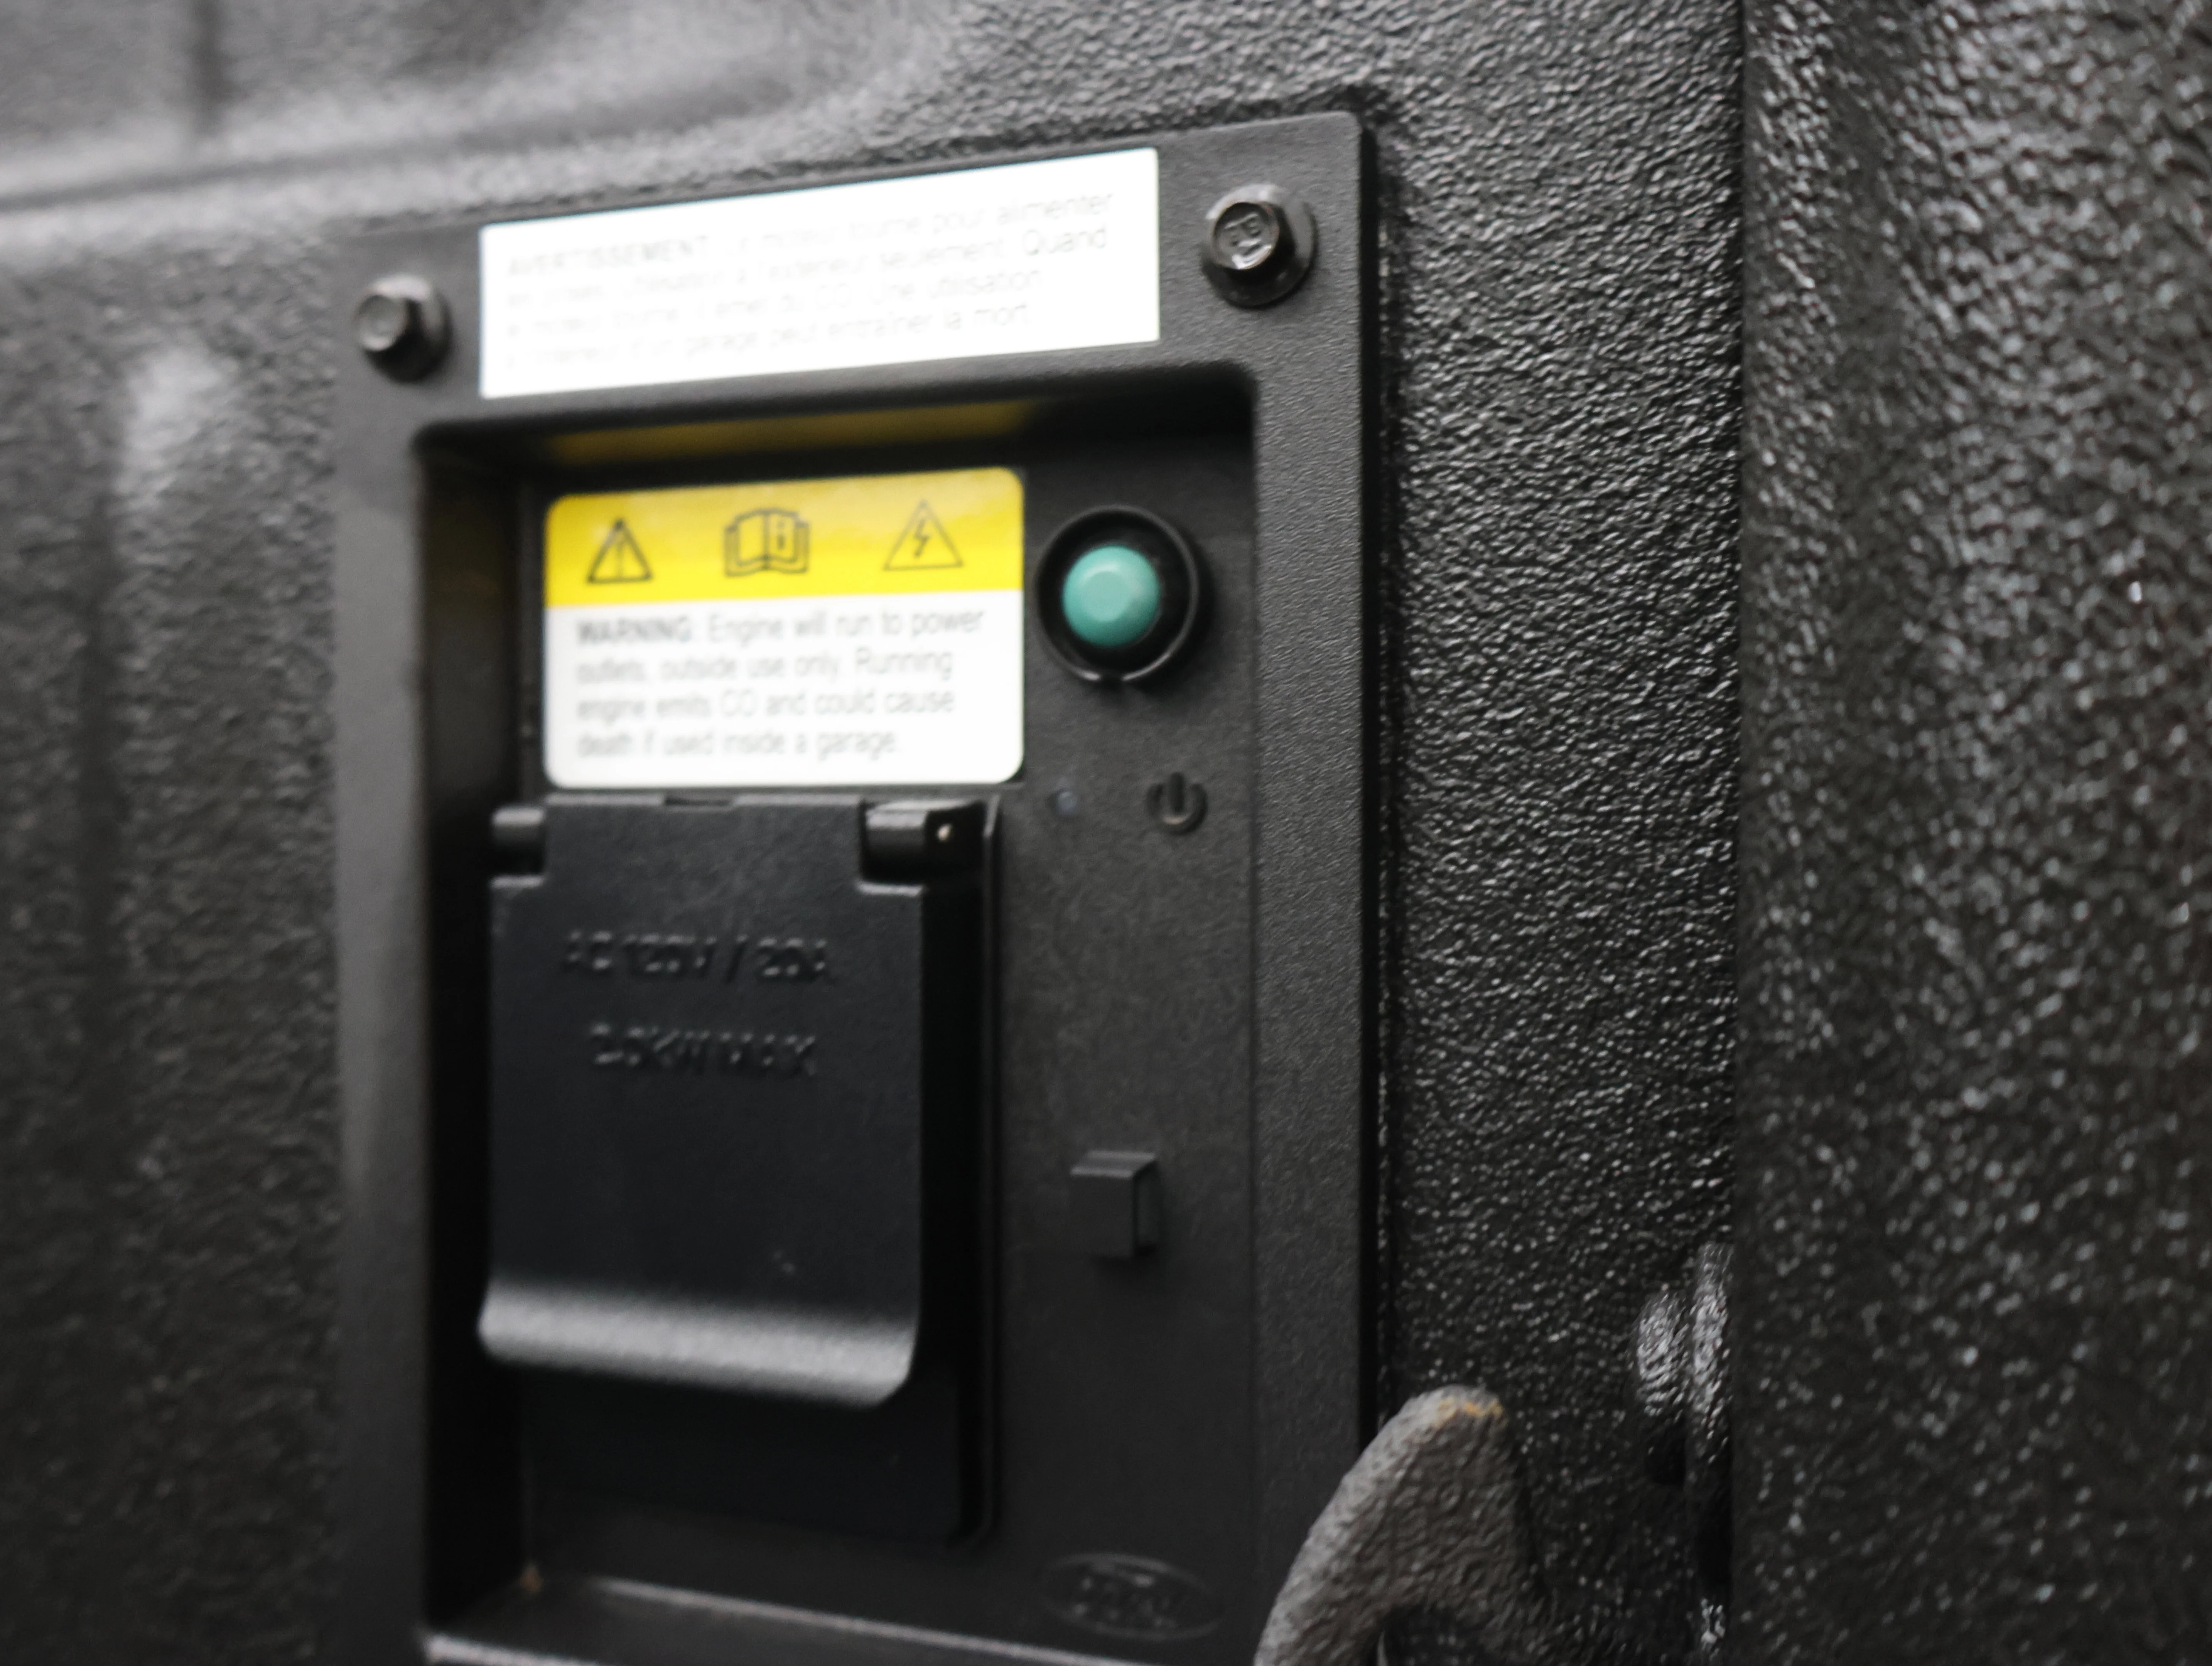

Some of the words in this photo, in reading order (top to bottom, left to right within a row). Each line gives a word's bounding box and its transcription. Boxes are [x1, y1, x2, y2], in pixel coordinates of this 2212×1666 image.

[849, 217, 923, 241] tourne
[932, 208, 986, 236] pour
[996, 192, 1115, 226] alimenter
[1021, 220, 1109, 258] Quand
[867, 279, 917, 306] Une
[926, 268, 1045, 301] utilisation
[683, 331, 759, 361] garage
[768, 320, 818, 351] peut
[943, 304, 963, 331] la
[708, 611, 785, 648] Engine
[794, 610, 827, 637] will
[836, 614, 871, 637] run
[880, 609, 903, 635] to
[911, 609, 985, 642] power
[660, 652, 737, 681] outside
[746, 657, 785, 680] use
[855, 645, 955, 681] Running
[575, 697, 646, 725] engine
[656, 694, 712, 718] emits
[721, 689, 757, 718] CO
[765, 690, 806, 717] and
[814, 688, 875, 716] could
[884, 690, 955, 715] cause
[576, 730, 633, 757] death
[663, 730, 714, 756] used
[723, 728, 785, 755] inside
[795, 733, 806, 754] a
